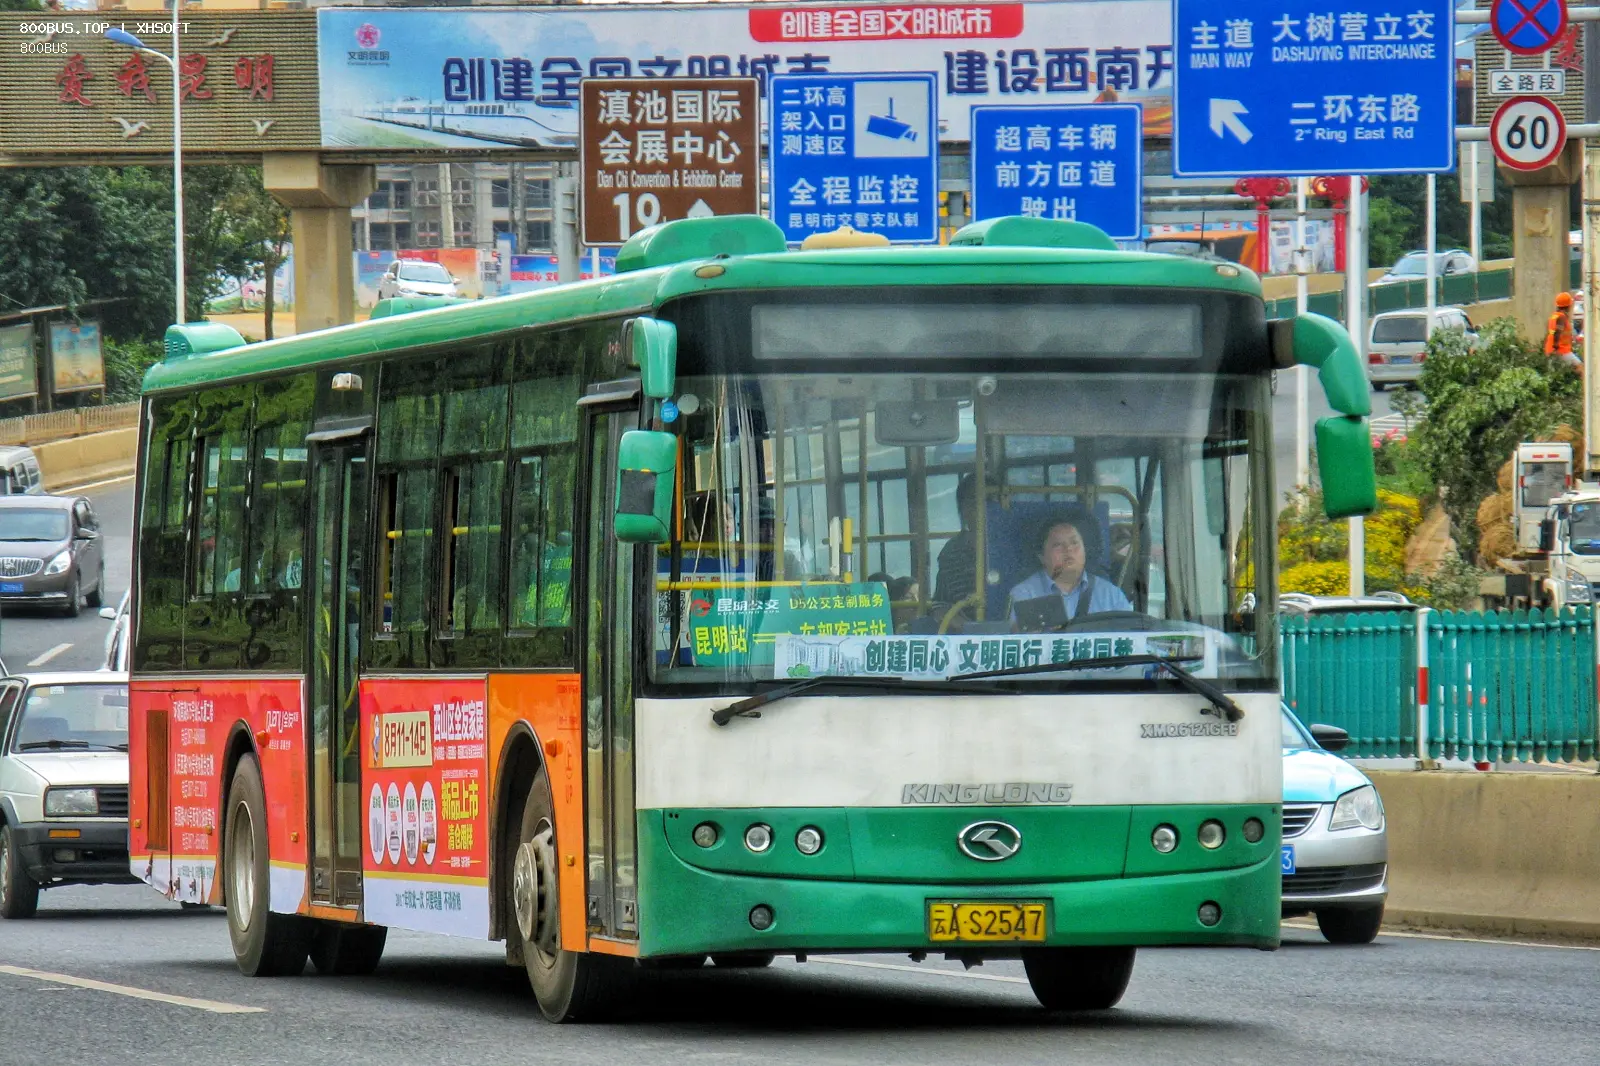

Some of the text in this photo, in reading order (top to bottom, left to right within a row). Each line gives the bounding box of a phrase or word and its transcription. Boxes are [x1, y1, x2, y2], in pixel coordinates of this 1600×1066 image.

[780, 9, 992, 38] 创建全国文明城市
[1190, 19, 1254, 49] 主道
[1272, 10, 1436, 43] 大树营立交
[1190, 52, 1254, 69] MAIN WAY
[1271, 43, 1437, 62] DASHUYING INTERCHANGE
[781, 86, 847, 107] 二环高
[1496, 73, 1559, 92] 全路段
[597, 89, 742, 125] 滇池国际
[781, 111, 846, 131] 架入口
[1289, 93, 1421, 124] 二环东路
[781, 134, 847, 156] 测速区
[995, 124, 1118, 151] 超高车辆
[1314, 127, 1348, 143] Ring
[1354, 127, 1386, 140] East
[1393, 126, 1415, 139] Rd
[1506, 115, 1550, 149] 60
[598, 130, 742, 166] 会展中心
[597, 168, 744, 188] Dian Chi Convention & Exhibition Center
[995, 160, 1117, 188] 前方匝道
[788, 174, 920, 206] 全程监控
[788, 212, 919, 228] 昆明市交警支队制
[1020, 196, 1077, 222] 驶出
[717, 598, 780, 612] 昆明公交
[694, 625, 748, 655] 昆明站
[865, 640, 950, 673] 创建同心
[958, 639, 1043, 672] 文明同行
[384, 719, 427, 758] 8月11-14日
[441, 778, 480, 821] 新品上市
